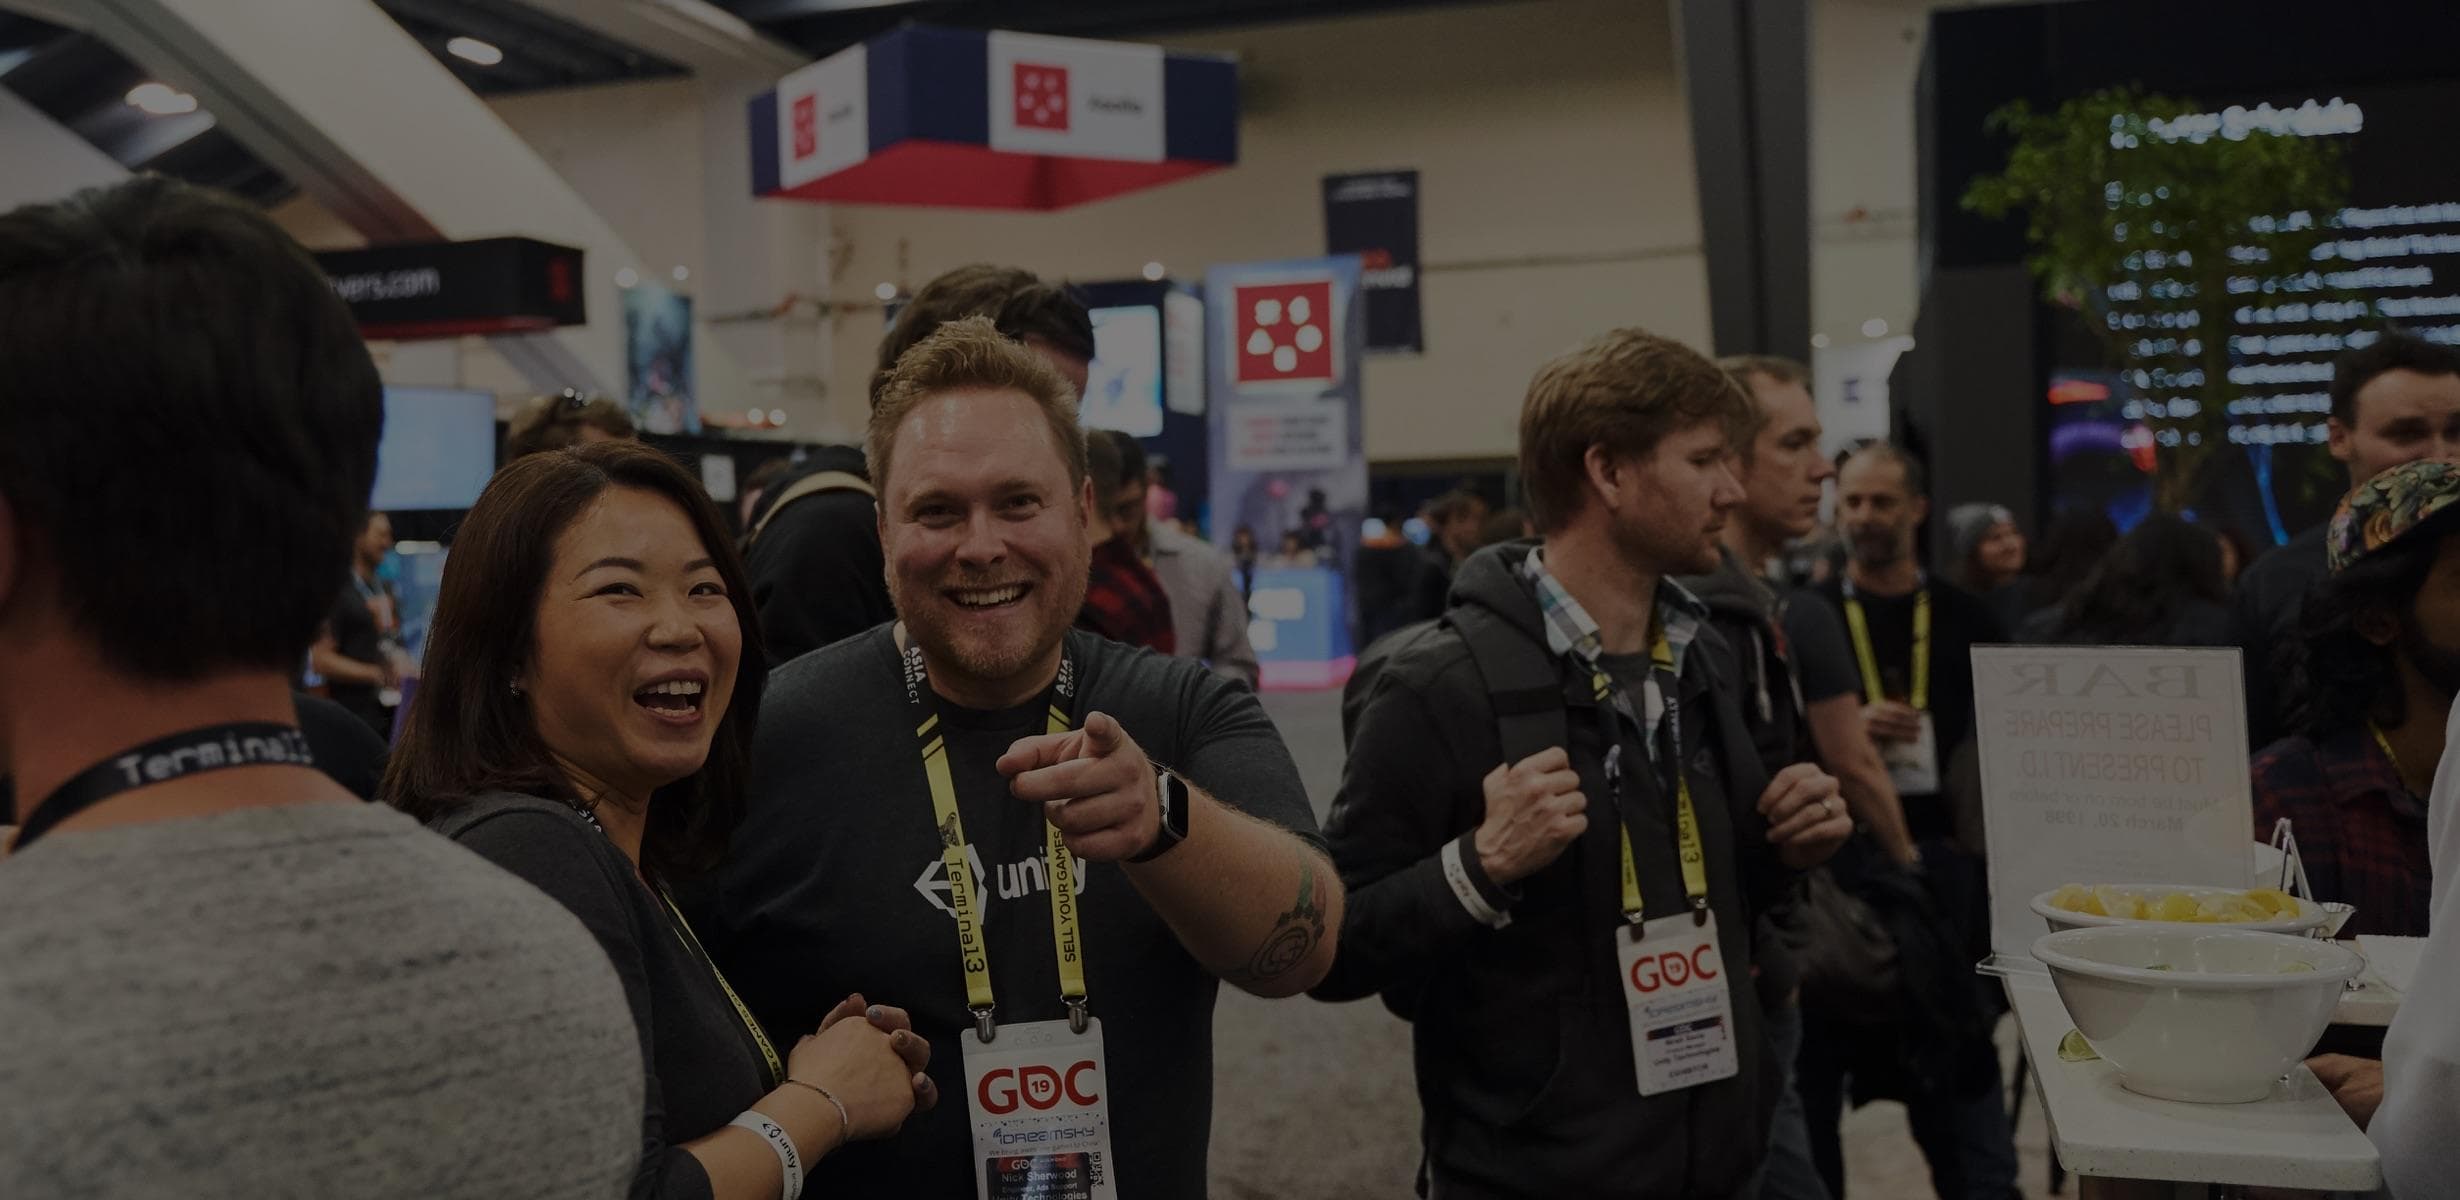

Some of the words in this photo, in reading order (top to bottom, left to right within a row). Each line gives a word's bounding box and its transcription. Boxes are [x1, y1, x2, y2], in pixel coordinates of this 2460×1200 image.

[902, 650, 920, 705] CONNECT
[911, 646, 927, 683] ASIA
[1055, 658, 1069, 696] ASIA
[1053, 830, 1069, 881] GAMES
[948, 858, 985, 974] Terminal3
[1058, 882, 1073, 925] YOUR
[1062, 926, 1077, 963] SELL
[1631, 944, 1718, 993] GDC
[978, 1060, 1100, 1115] GDC
[1031, 1079, 1050, 1094] 19
[779, 1138, 797, 1169] unity
[1026, 1169, 1078, 1182] Sherwood
